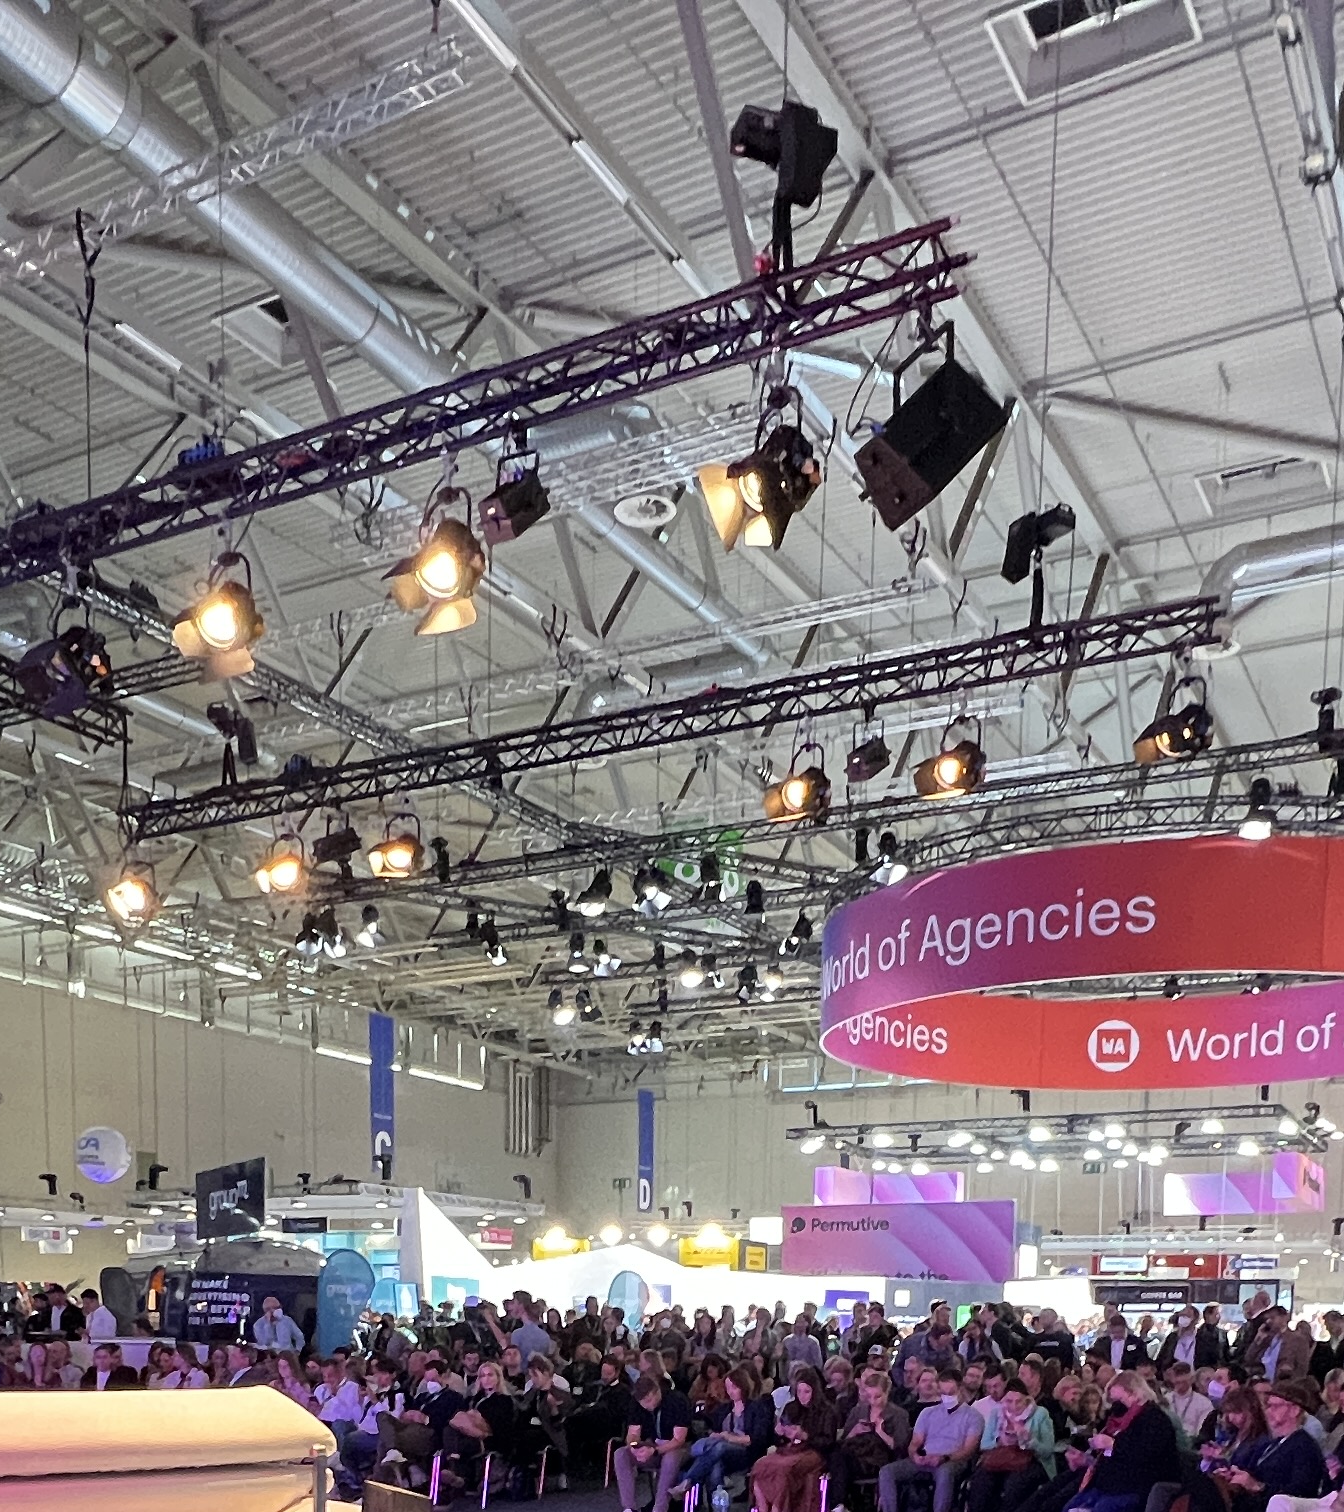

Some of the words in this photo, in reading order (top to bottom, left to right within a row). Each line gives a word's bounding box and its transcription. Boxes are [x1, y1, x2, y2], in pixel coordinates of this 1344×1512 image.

[878, 919, 911, 971] of
[919, 887, 1156, 966] Agencies
[1101, 1037, 1126, 1055] WA
[1166, 1019, 1285, 1062] World
[1296, 1012, 1337, 1053] of
[639, 1178, 651, 1210] D
[811, 1216, 890, 1232] Permutive
